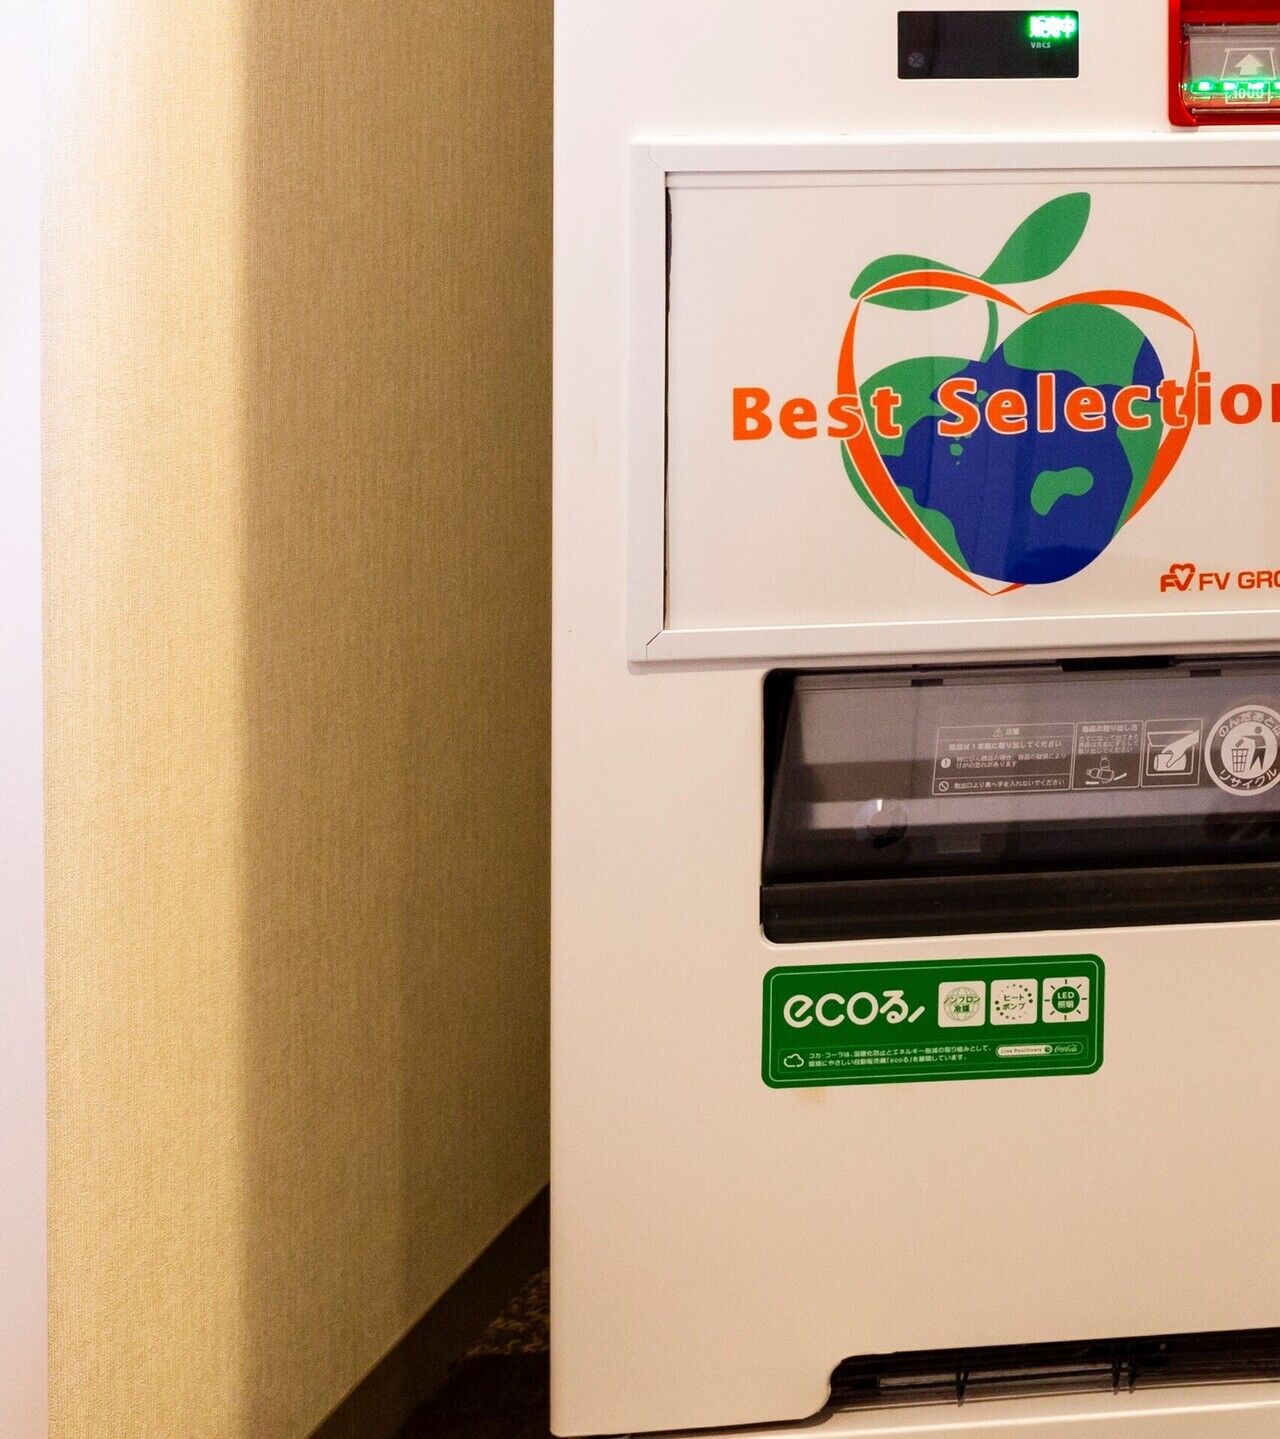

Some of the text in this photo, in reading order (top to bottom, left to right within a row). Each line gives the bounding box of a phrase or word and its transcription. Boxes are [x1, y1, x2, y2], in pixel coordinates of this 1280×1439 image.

[732, 384, 903, 442] Best
[1199, 572, 1232, 590] FV
[1217, 766, 1278, 789] リサイクル
[943, 995, 981, 1006] ノンフロン
[1003, 993, 1025, 1003] ヒート
[1056, 991, 1076, 1001] LED
[1002, 1001, 1026, 1012] ポンプ
